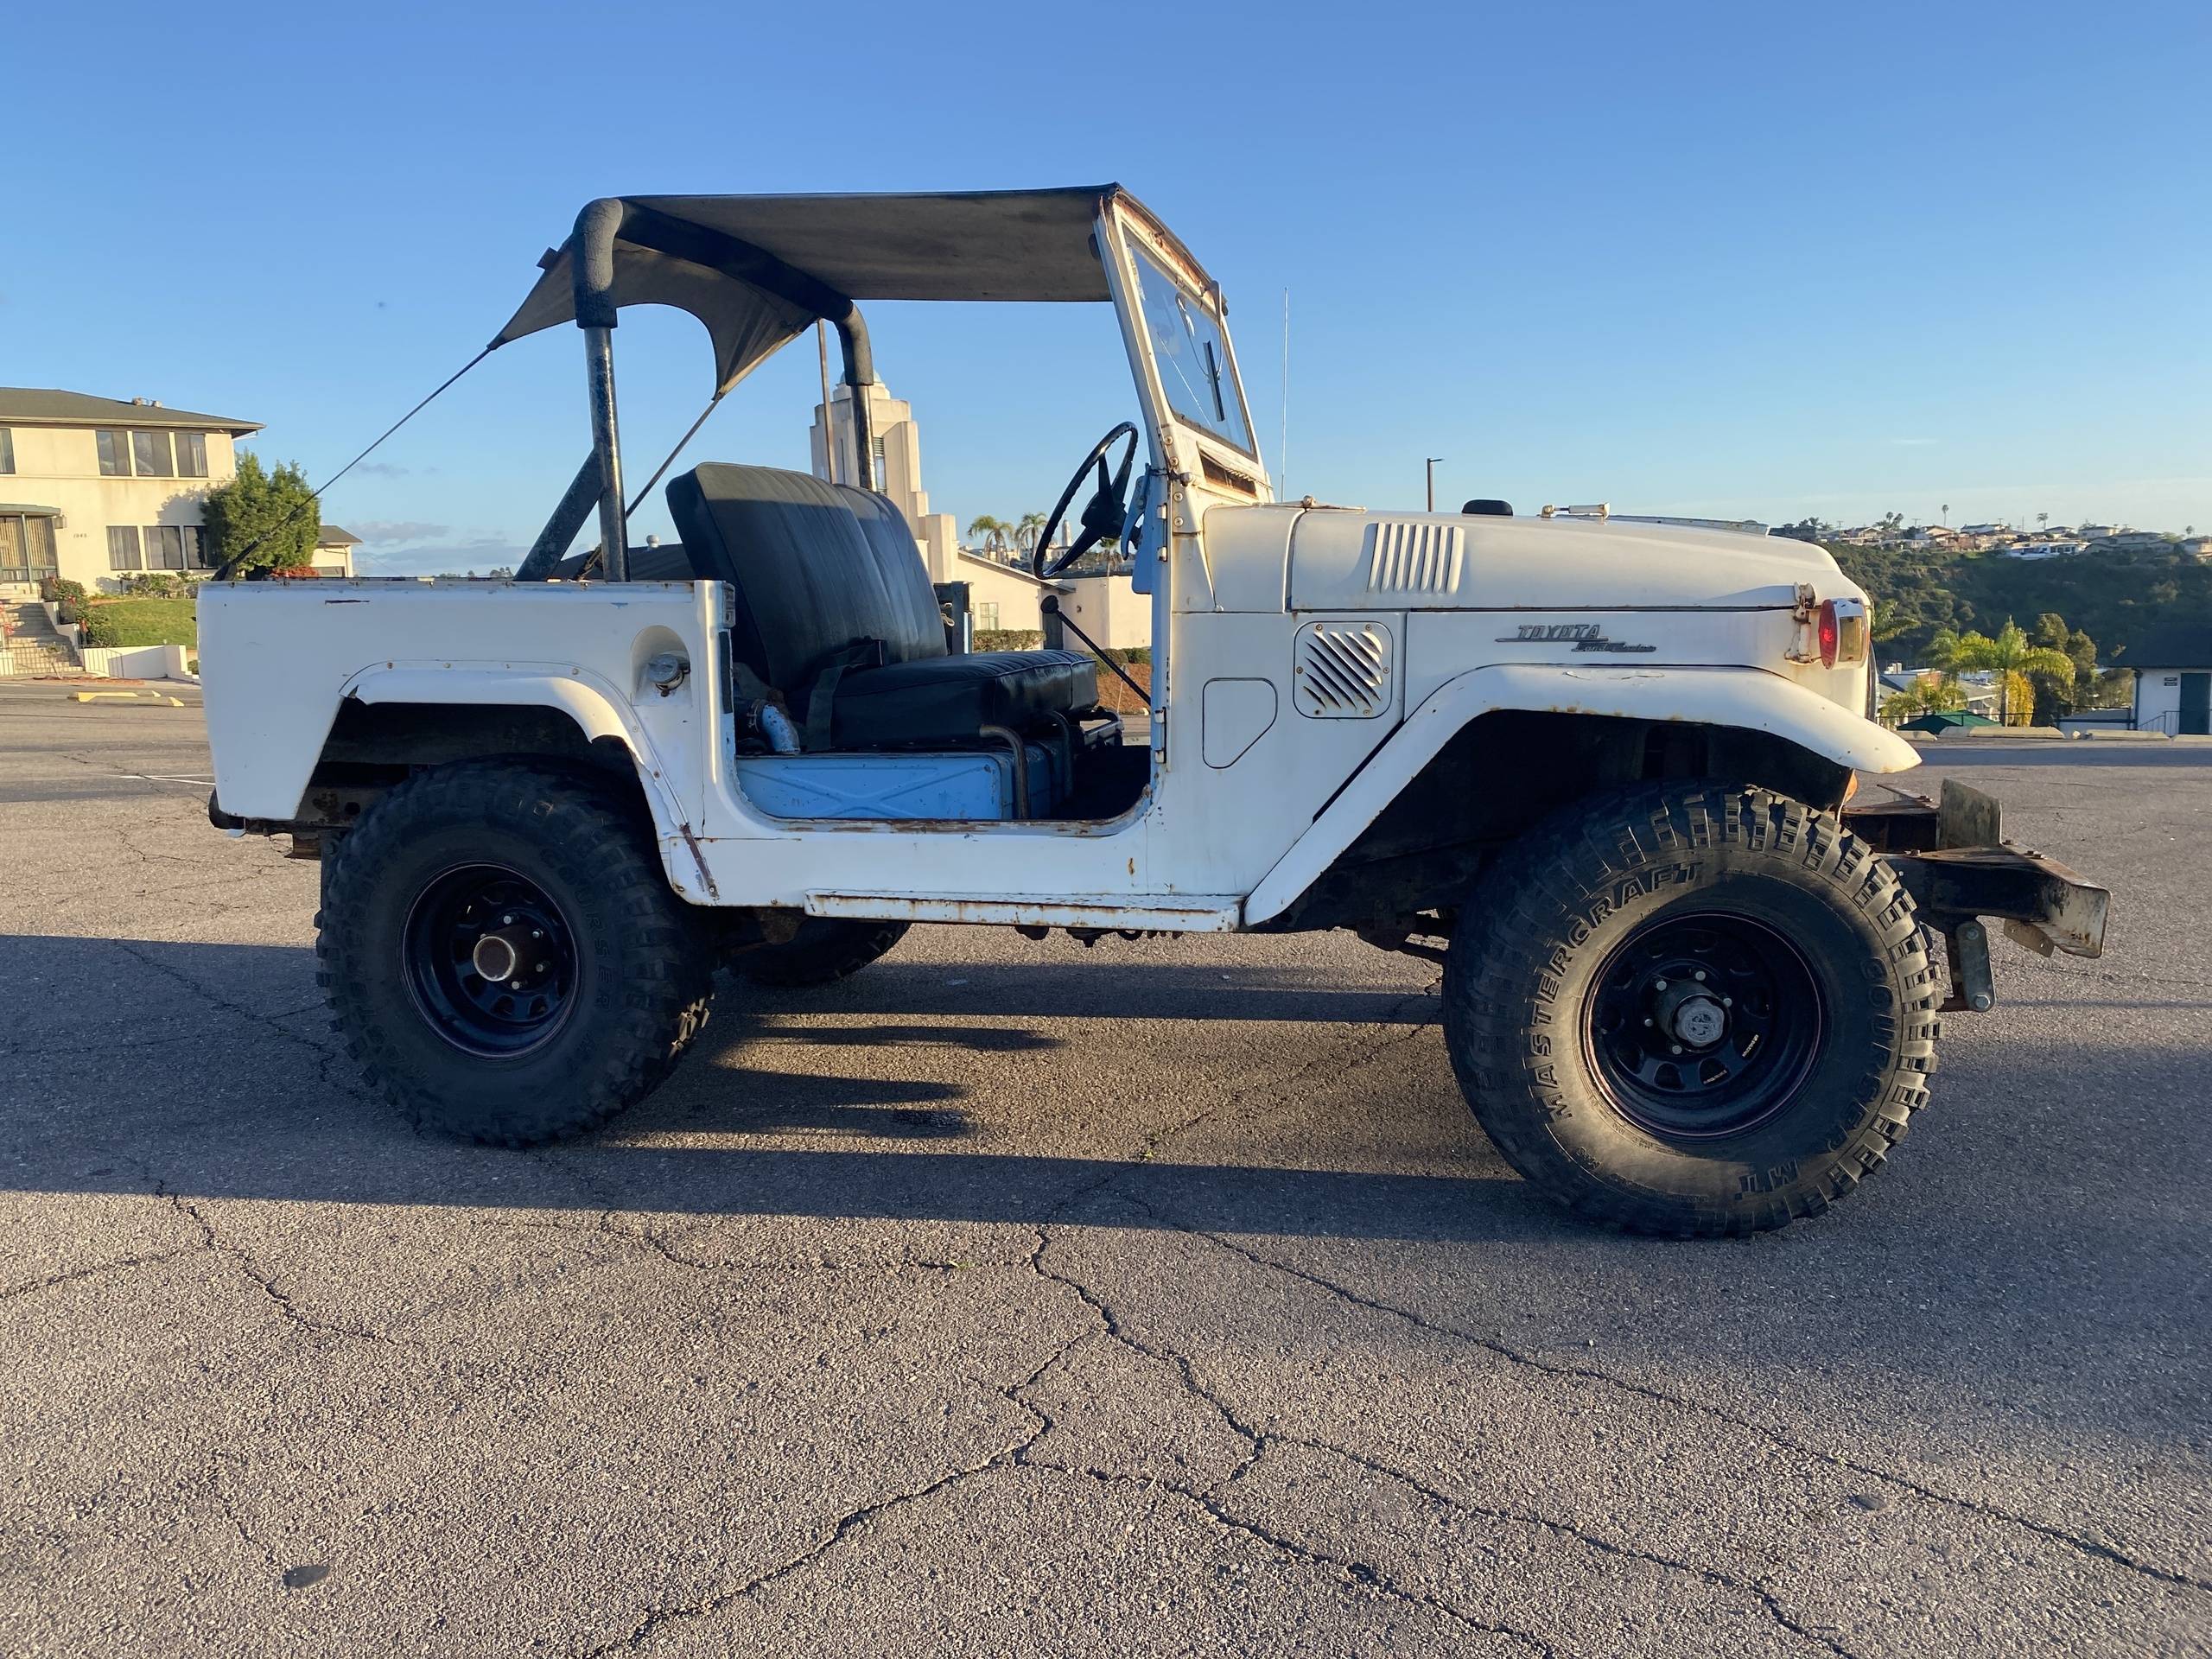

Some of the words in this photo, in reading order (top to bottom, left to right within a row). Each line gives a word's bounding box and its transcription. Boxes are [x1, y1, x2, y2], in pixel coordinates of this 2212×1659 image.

[1517, 624, 1601, 640] TOYOTA
[1528, 861, 1703, 1124] MASTERCRAFT
[1827, 957, 1897, 1153] COURSER
